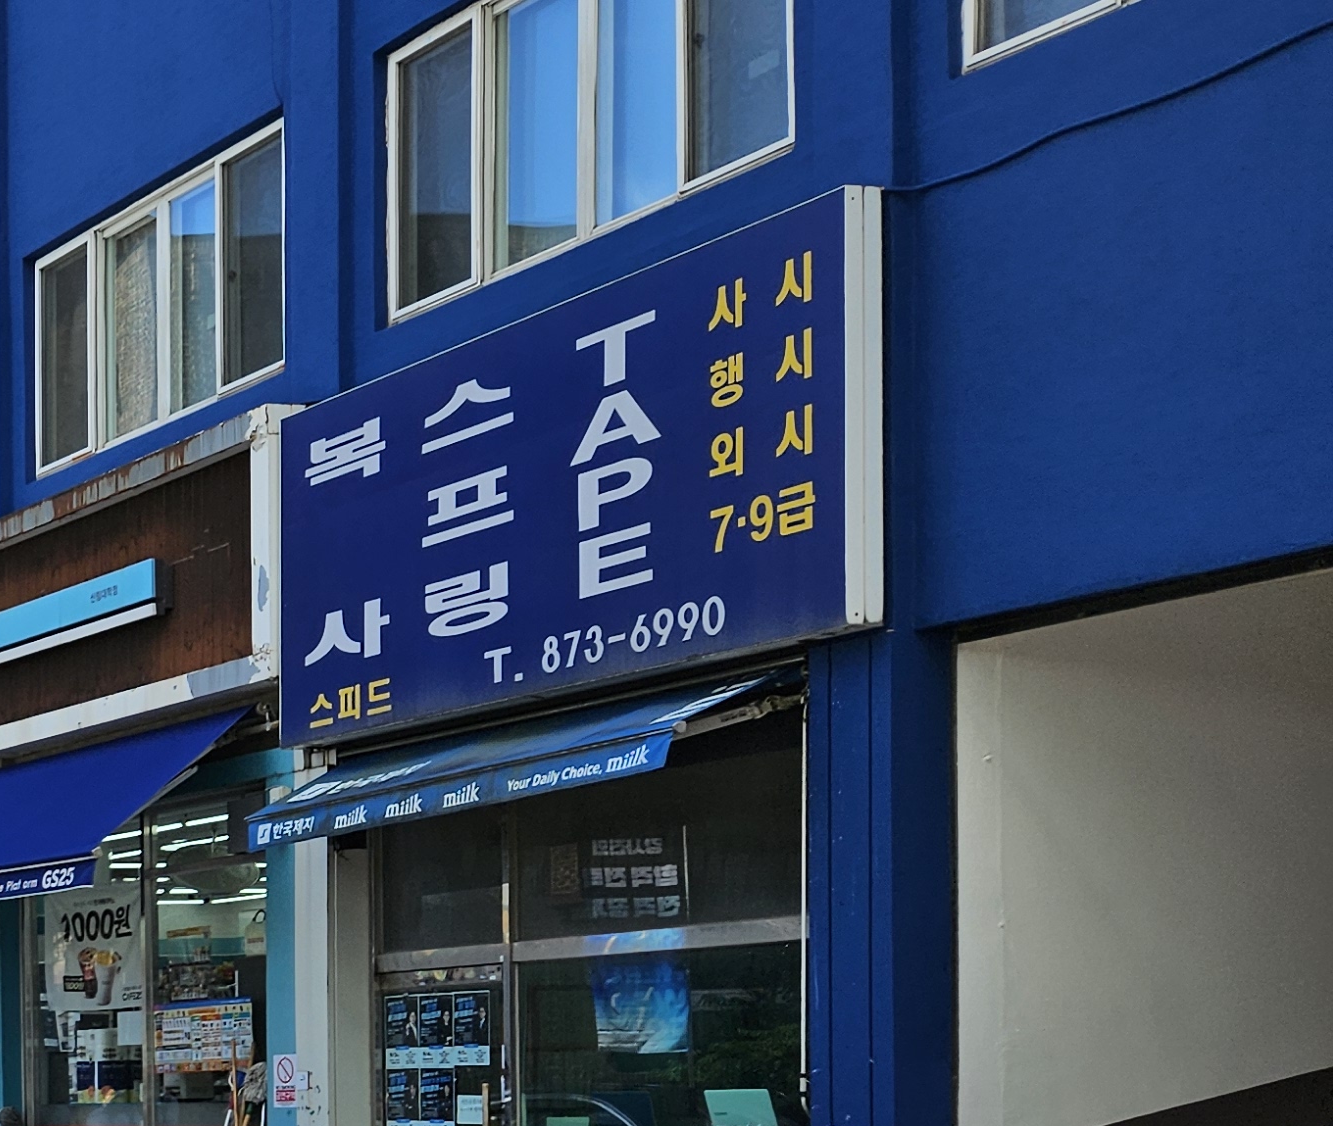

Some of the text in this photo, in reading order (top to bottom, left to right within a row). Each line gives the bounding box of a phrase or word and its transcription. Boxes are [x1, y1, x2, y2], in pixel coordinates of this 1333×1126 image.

[569, 309, 662, 600] TAPE
[421, 378, 515, 637] 스프링
[483, 594, 727, 684] T. 873-6990
[308, 676, 392, 730] 스피드
[506, 743, 651, 792] Your Daily Choice, miilk
[272, 781, 480, 840] 한국제지 miilk miilk miilk
[41, 866, 75, 889] GS25
[61, 904, 132, 942] 1000원
